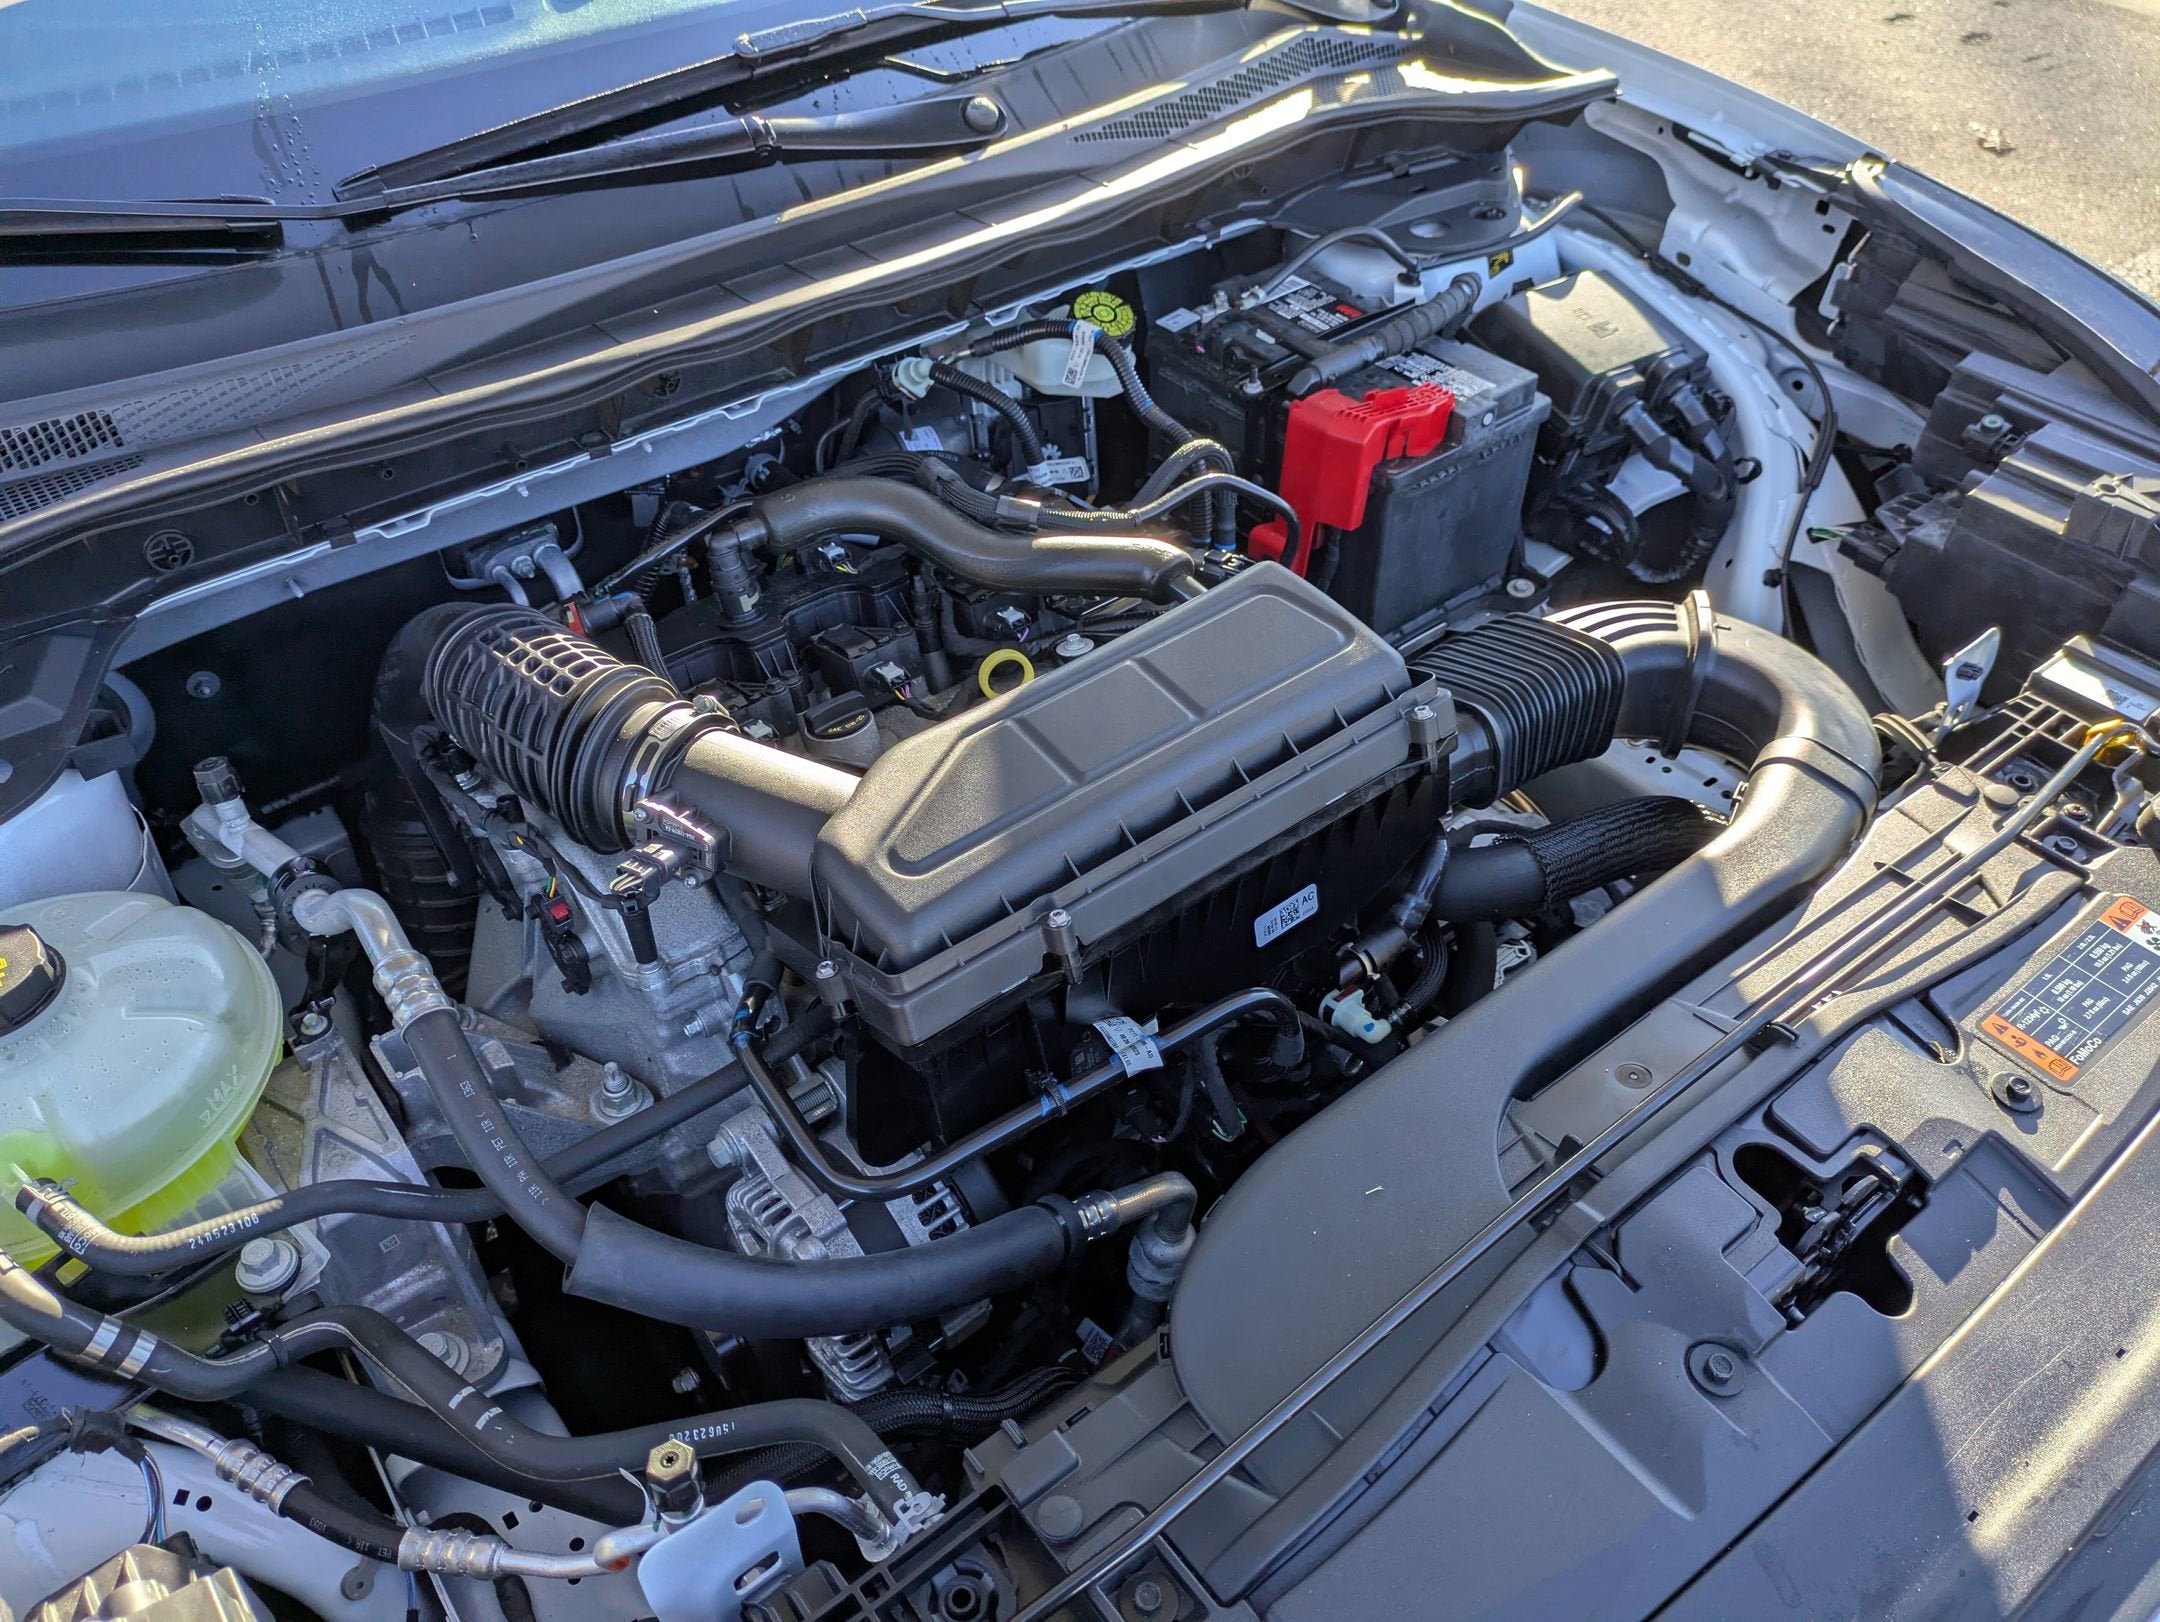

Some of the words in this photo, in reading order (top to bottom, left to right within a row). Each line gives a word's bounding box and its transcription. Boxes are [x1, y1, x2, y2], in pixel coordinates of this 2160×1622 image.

[1301, 891, 1315, 906] AC
[2120, 961, 2133, 971] PAG
[2061, 977, 2073, 986] kg
[2081, 997, 2094, 1007] PAG
[2121, 1004, 2135, 1015] SAE
[2016, 1008, 2043, 1031] R-1234yf
[2044, 1034, 2060, 1047] PAG
[2068, 1035, 2103, 1065] FoMoCo
[490, 1136, 505, 1152] PET
[890, 1473, 908, 1493] RAD
